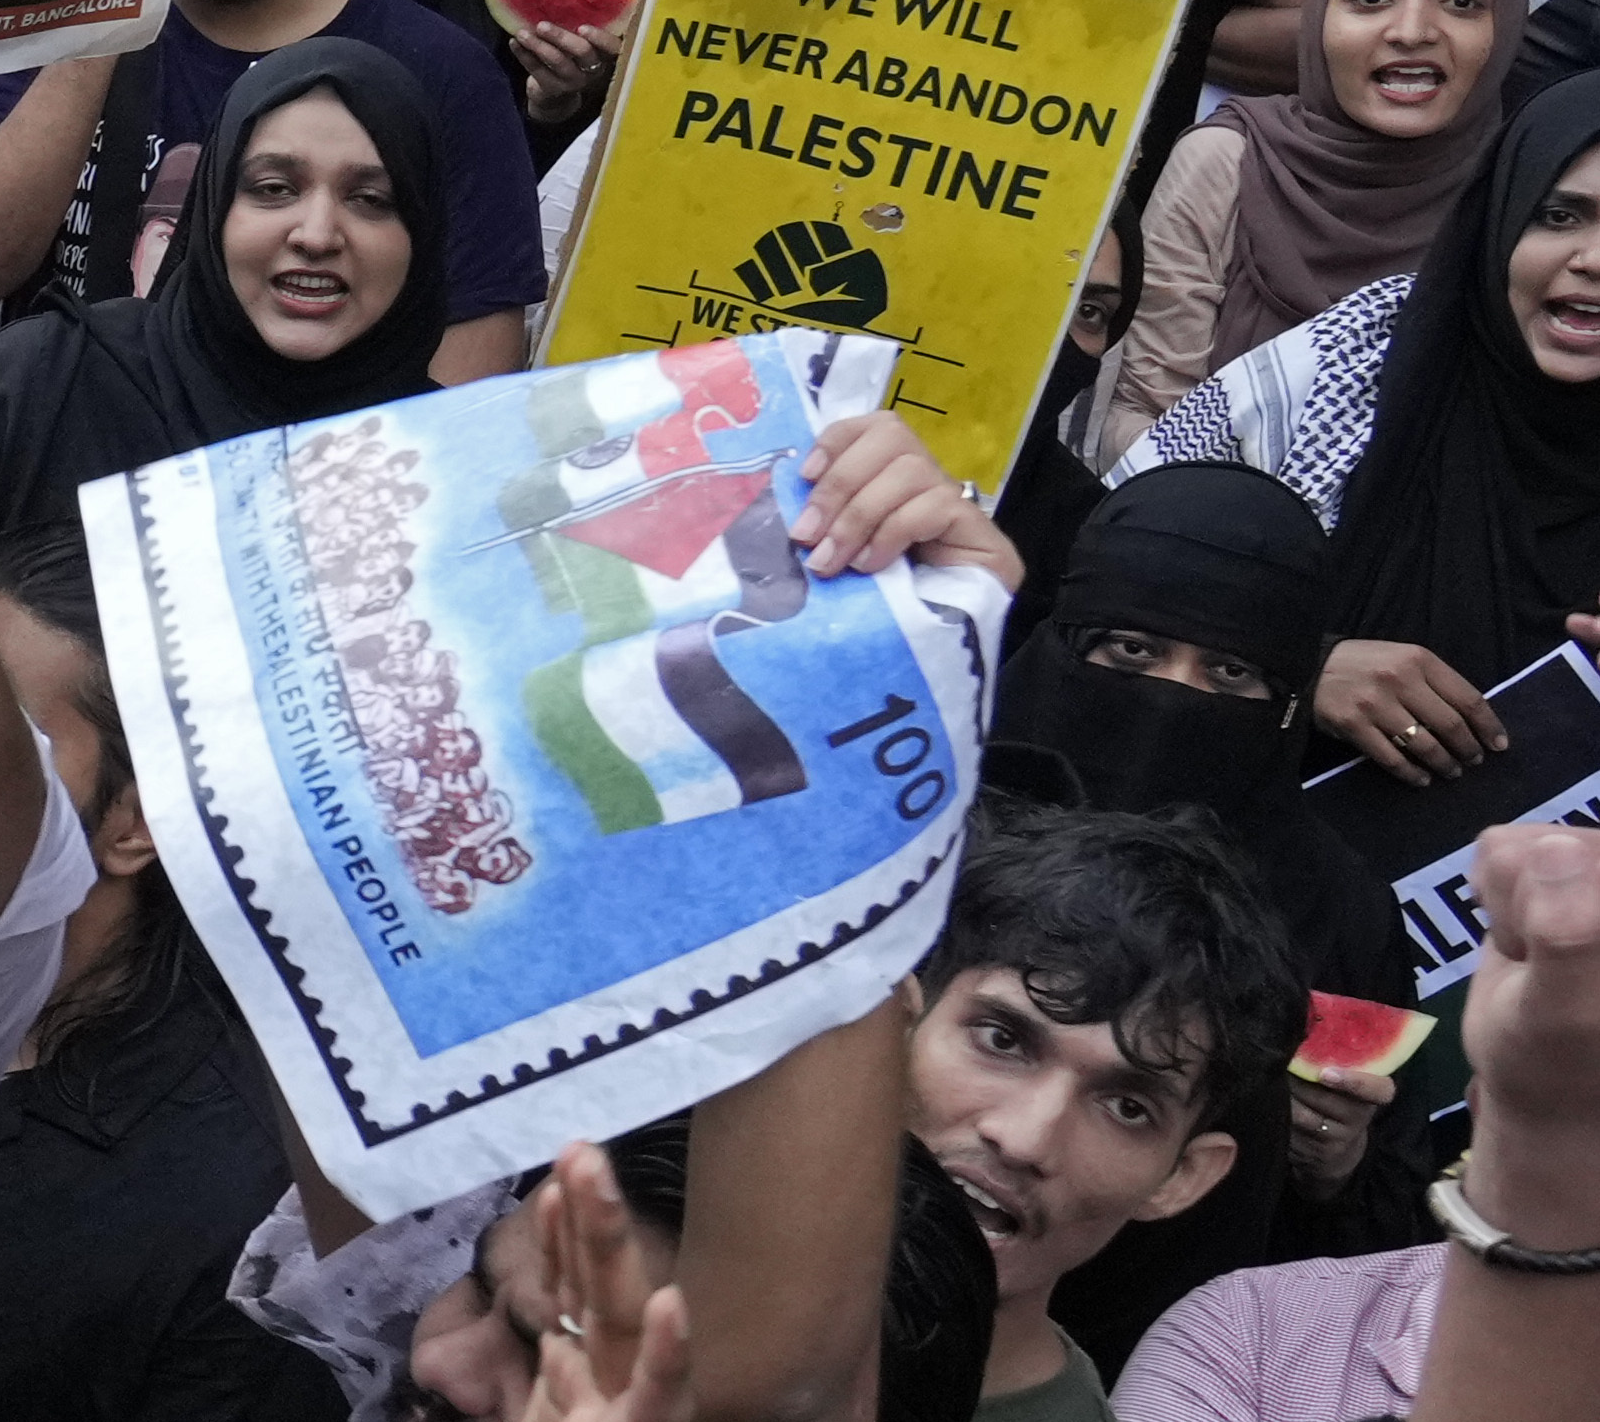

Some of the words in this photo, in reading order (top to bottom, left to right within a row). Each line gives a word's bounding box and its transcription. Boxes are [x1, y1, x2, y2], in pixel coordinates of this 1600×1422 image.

[655, 16, 829, 80] NEVER
[831, 49, 1119, 148] ABANDON
[673, 90, 1050, 221] PALESTINE
[690, 295, 745, 335] WE
[239, 542, 272, 586] WITH
[249, 582, 288, 639] THE
[262, 633, 352, 834] PALESTINIAN
[827, 692, 949, 823] 100
[330, 834, 424, 969] PEOPLE
